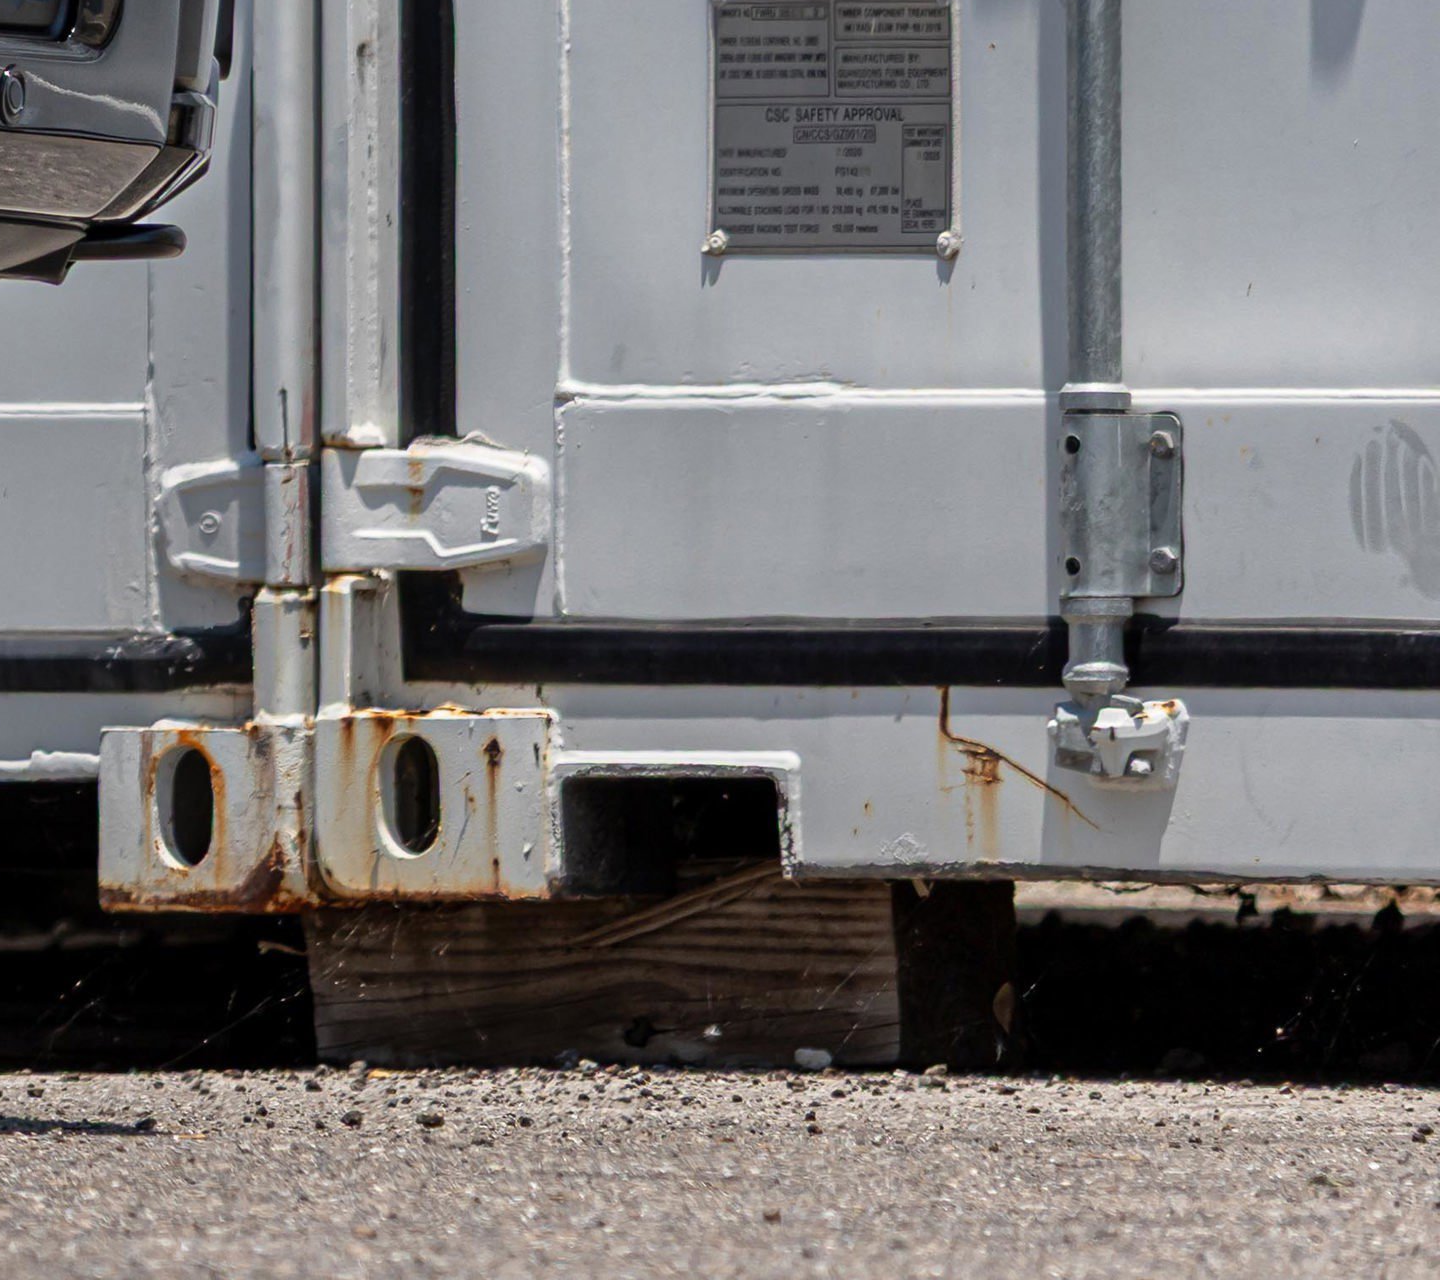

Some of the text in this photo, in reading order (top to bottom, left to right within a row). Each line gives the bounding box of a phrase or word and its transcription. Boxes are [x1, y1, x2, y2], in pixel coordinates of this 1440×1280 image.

[765, 107, 904, 123] CSC SAFETY APPROVAL
